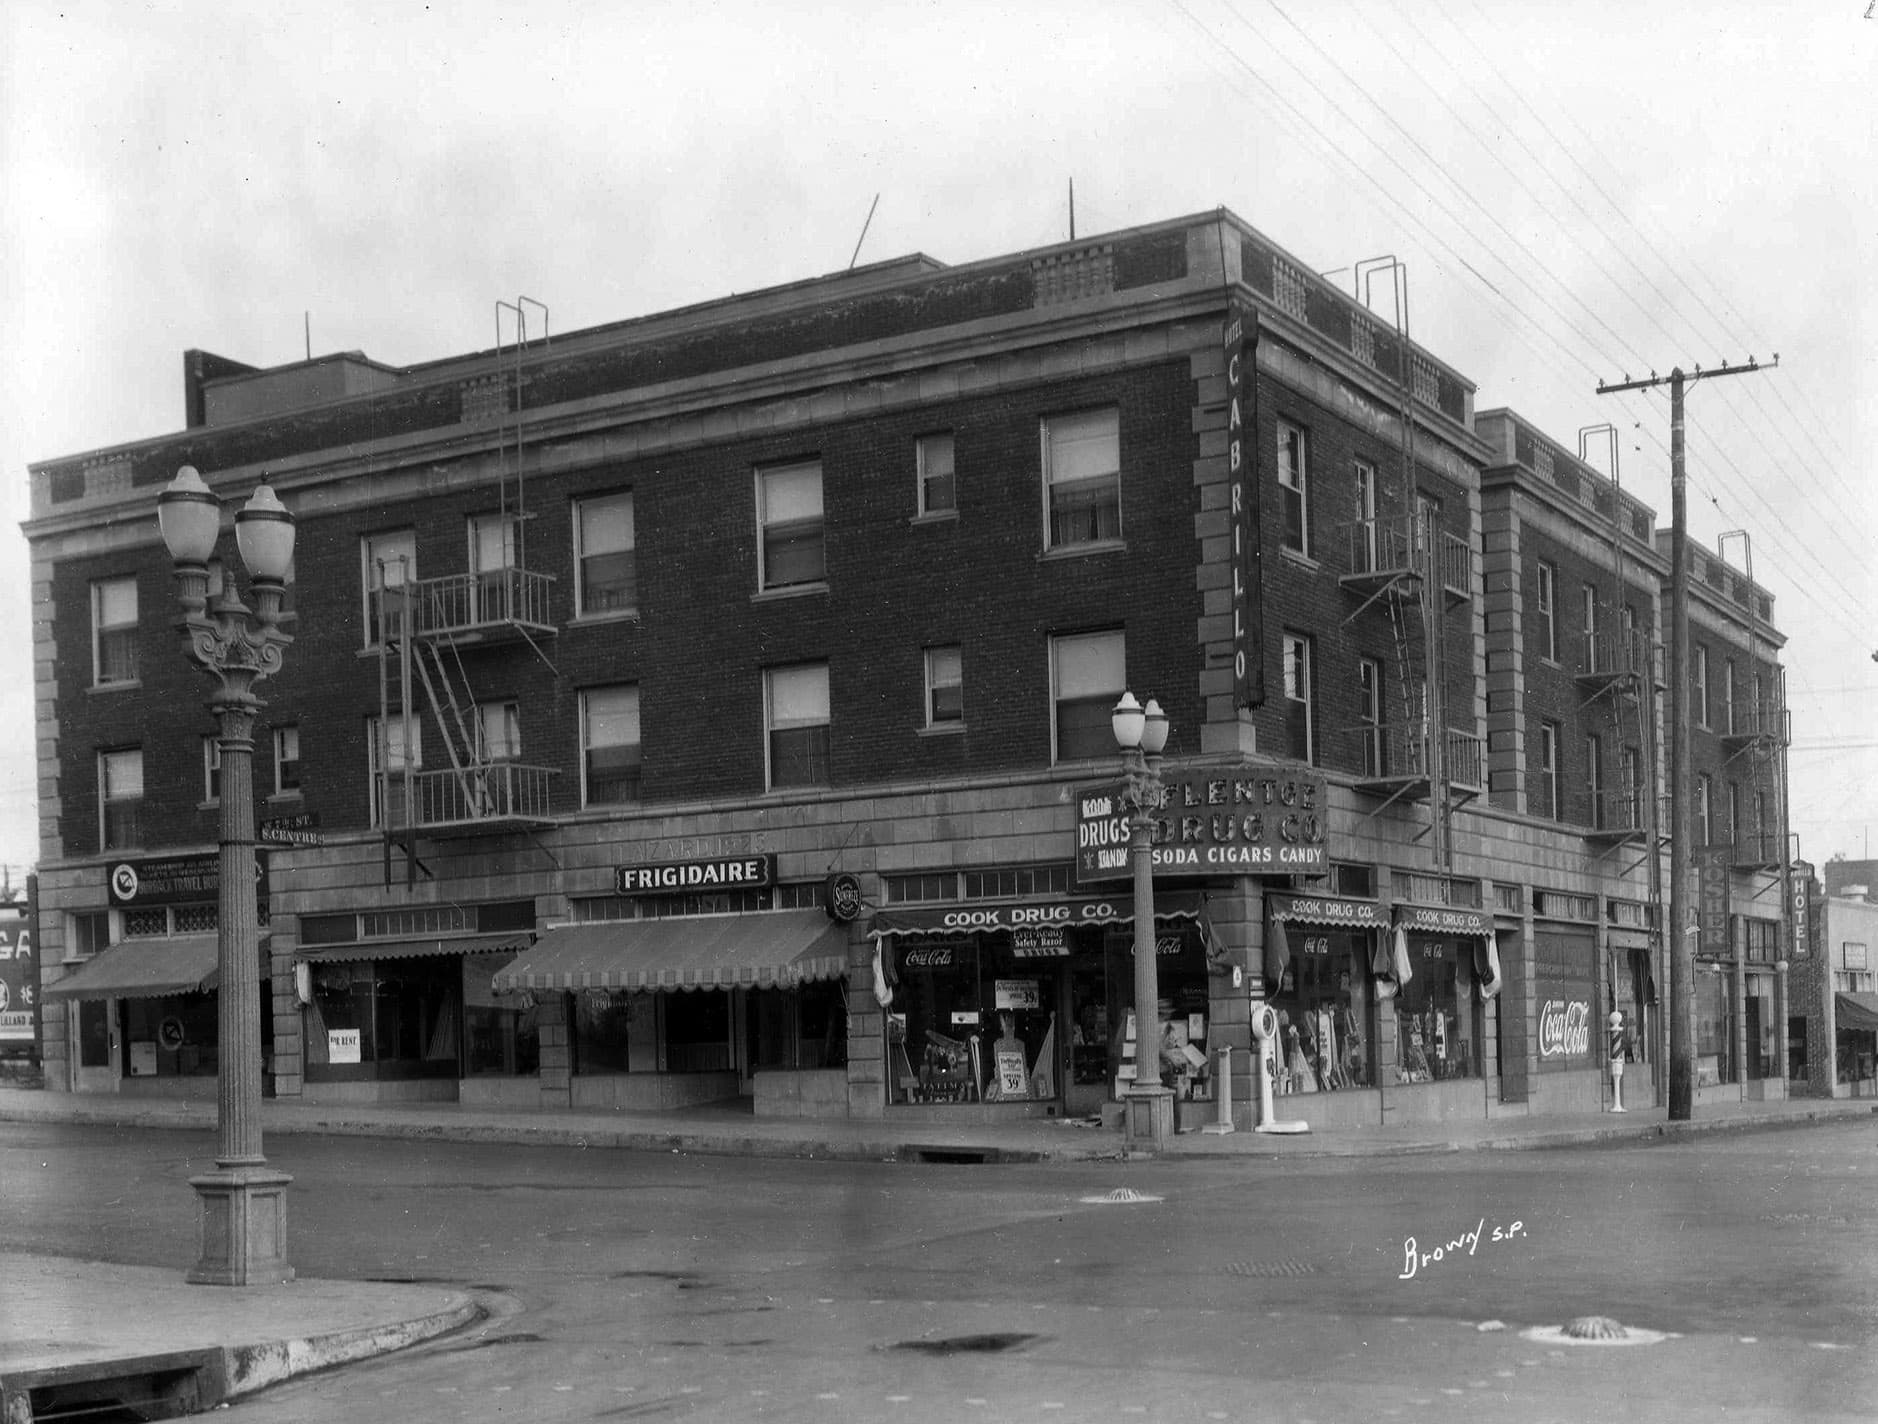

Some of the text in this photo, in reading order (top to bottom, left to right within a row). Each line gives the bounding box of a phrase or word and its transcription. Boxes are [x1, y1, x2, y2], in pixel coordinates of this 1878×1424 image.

[1228, 354, 1246, 681] CABRILLO
[1080, 816, 1131, 848] DRUGS
[1152, 813, 1263, 842] DRUG
[1152, 847, 1322, 864] SODA CIGARS CANDY
[174, 876, 202, 892] TRAVEL
[624, 860, 759, 889] FRIGIDAIRE
[944, 903, 1117, 926] COOK DRUG CO.
[1292, 900, 1373, 918] COOK DRUG CO.
[1416, 910, 1439, 925] COOK
[1443, 913, 1465, 927] DRUG
[1794, 880, 1806, 953] HOTEL
[1015, 938, 1037, 948] Safety
[341, 1036, 356, 1046] RENT
